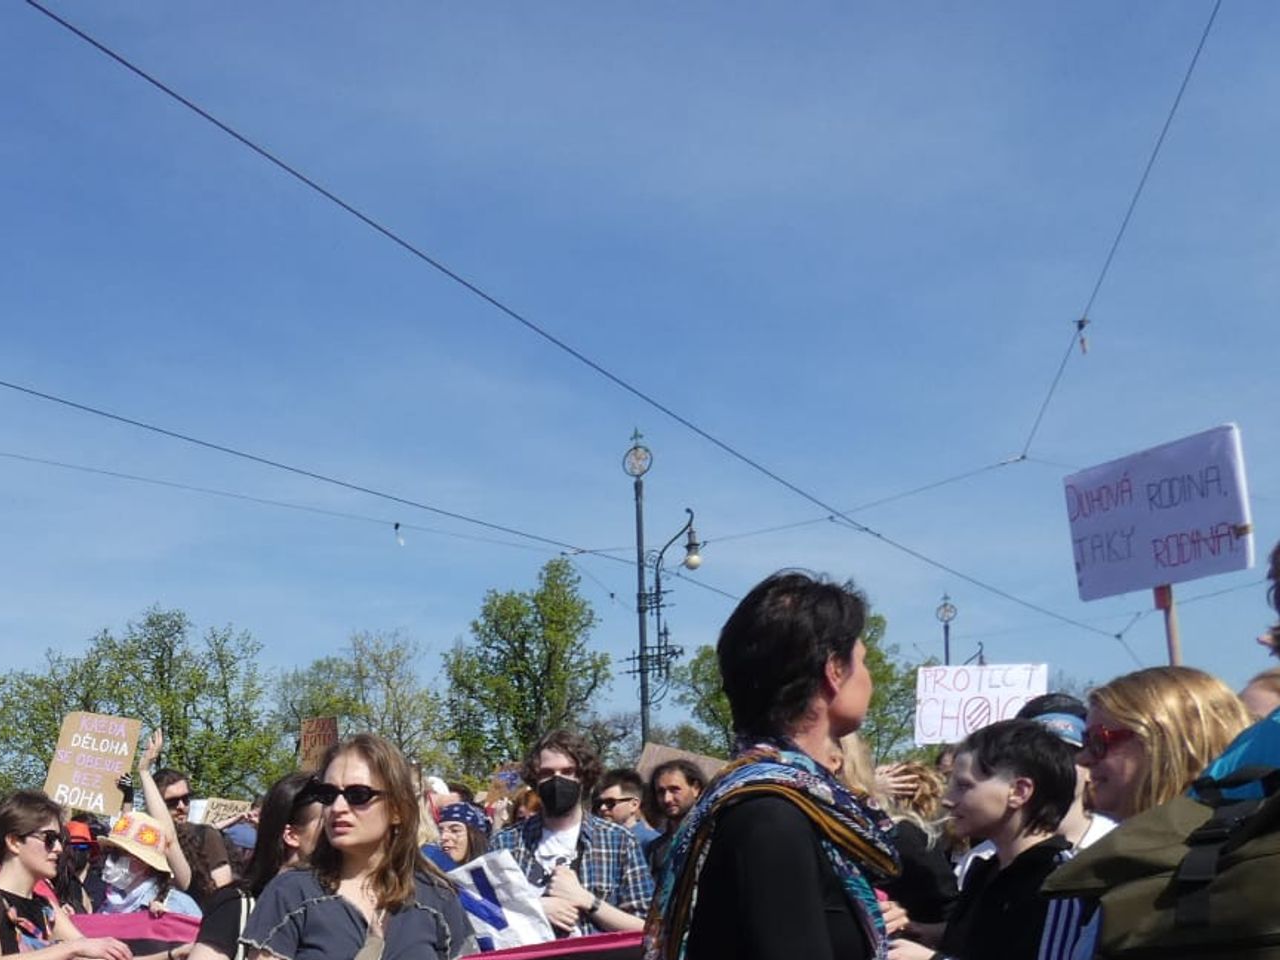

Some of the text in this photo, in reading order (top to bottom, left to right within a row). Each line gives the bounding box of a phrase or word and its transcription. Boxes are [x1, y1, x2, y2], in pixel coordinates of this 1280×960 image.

[1073, 526, 1137, 566] TAKY
[921, 668, 1038, 692] PROTECT
[919, 695, 1036, 737] CHOIC
